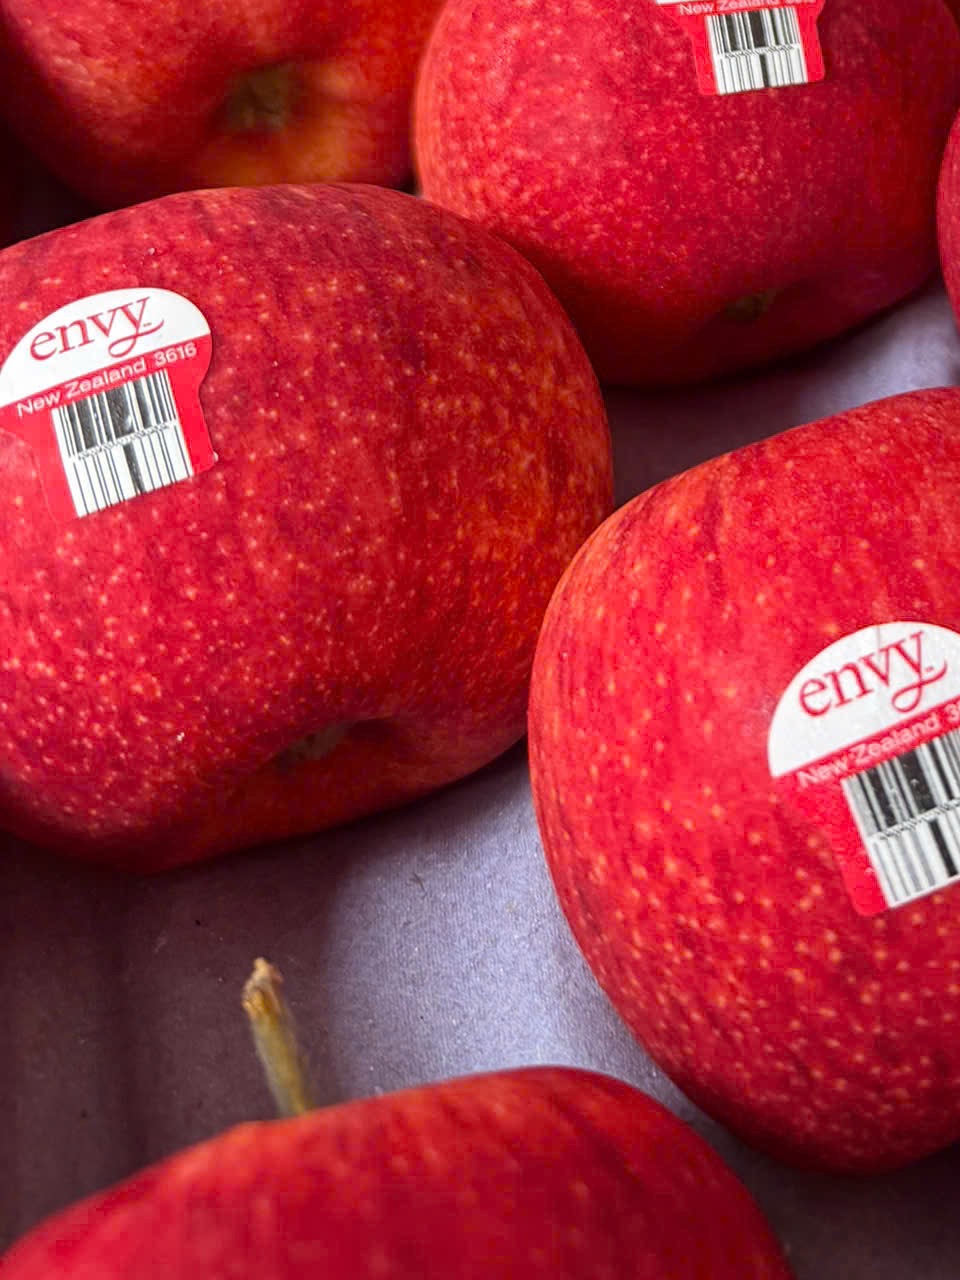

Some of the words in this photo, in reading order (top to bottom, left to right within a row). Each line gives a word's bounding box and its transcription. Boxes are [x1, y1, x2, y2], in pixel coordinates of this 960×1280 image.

[679, 2, 715, 16] New
[29, 296, 165, 362] envy
[16, 392, 61, 419] New
[64, 357, 147, 399] Zealand
[153, 342, 198, 368] 3616
[798, 631, 949, 718] envy
[796, 757, 850, 789] New
[850, 714, 941, 765] Zealand
